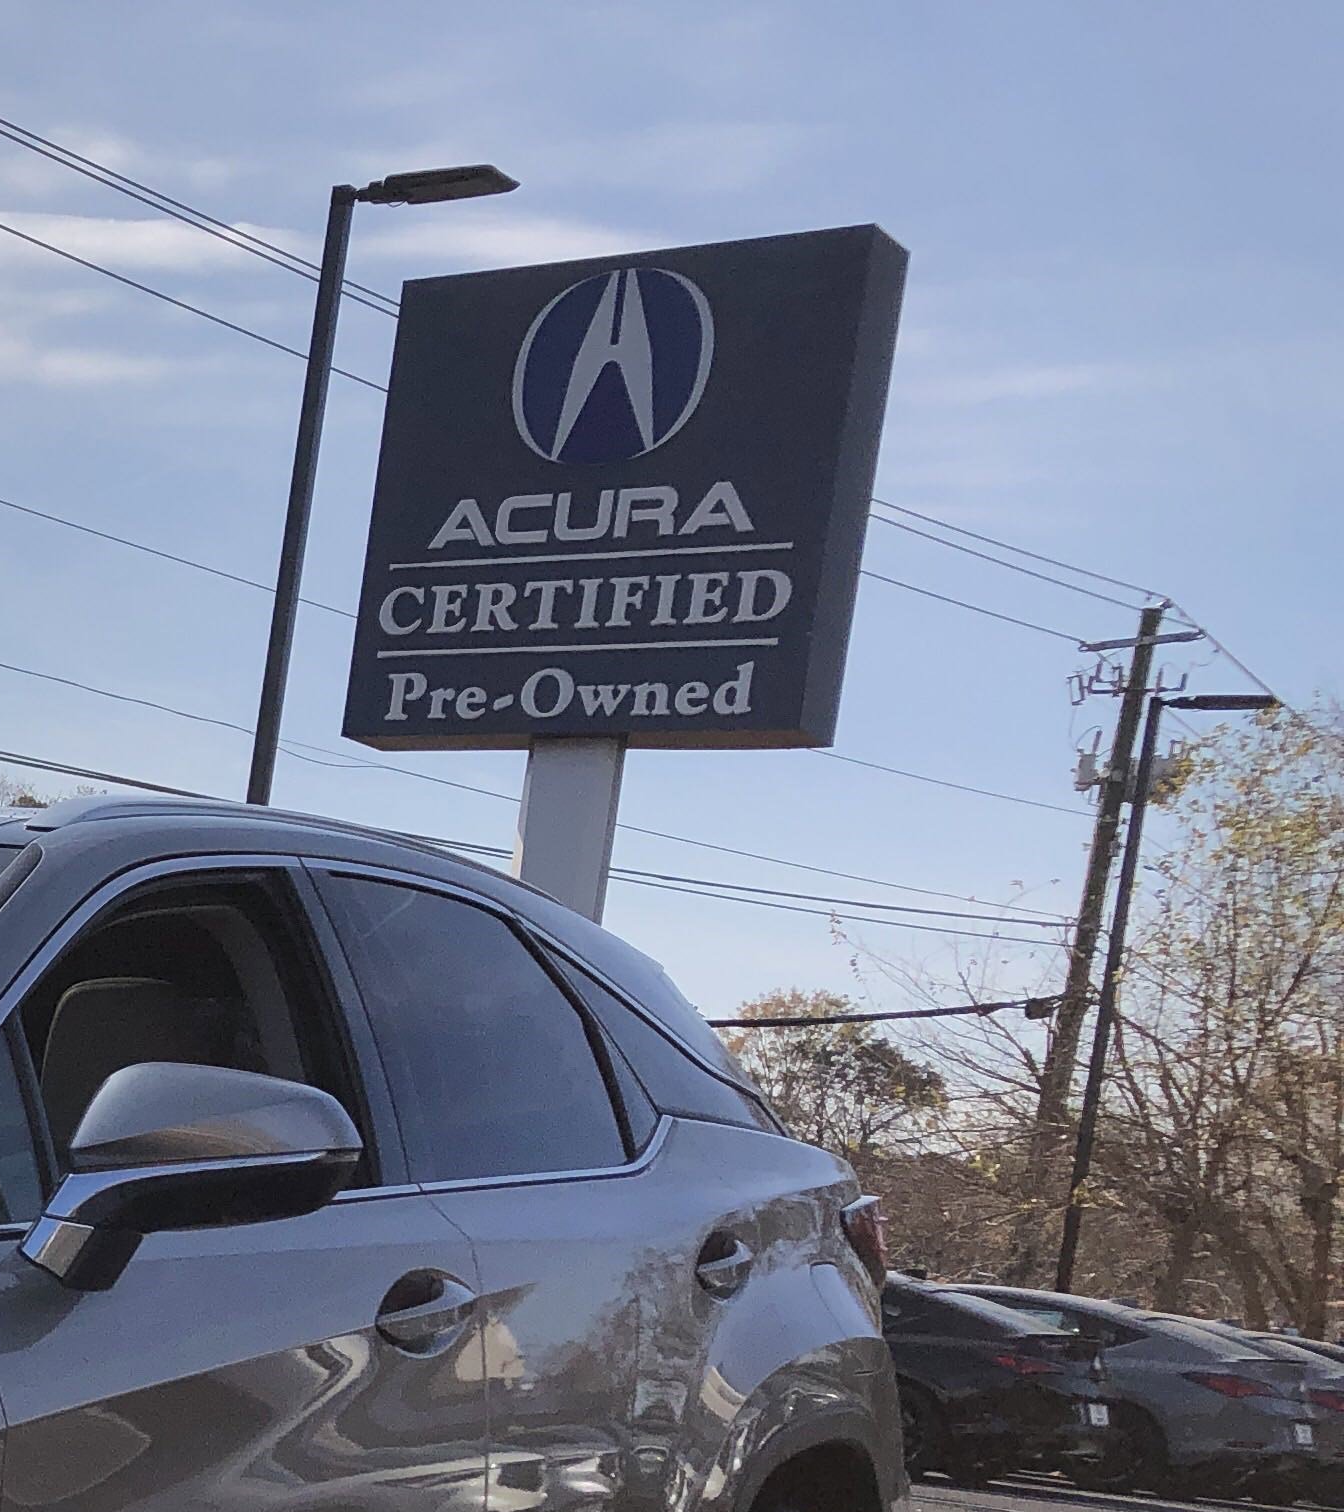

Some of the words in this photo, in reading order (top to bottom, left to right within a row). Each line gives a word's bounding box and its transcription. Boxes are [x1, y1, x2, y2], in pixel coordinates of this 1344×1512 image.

[427, 481, 756, 550] ACURA
[378, 567, 794, 637] CERTIFIED
[383, 660, 757, 722] Pre-Owned
